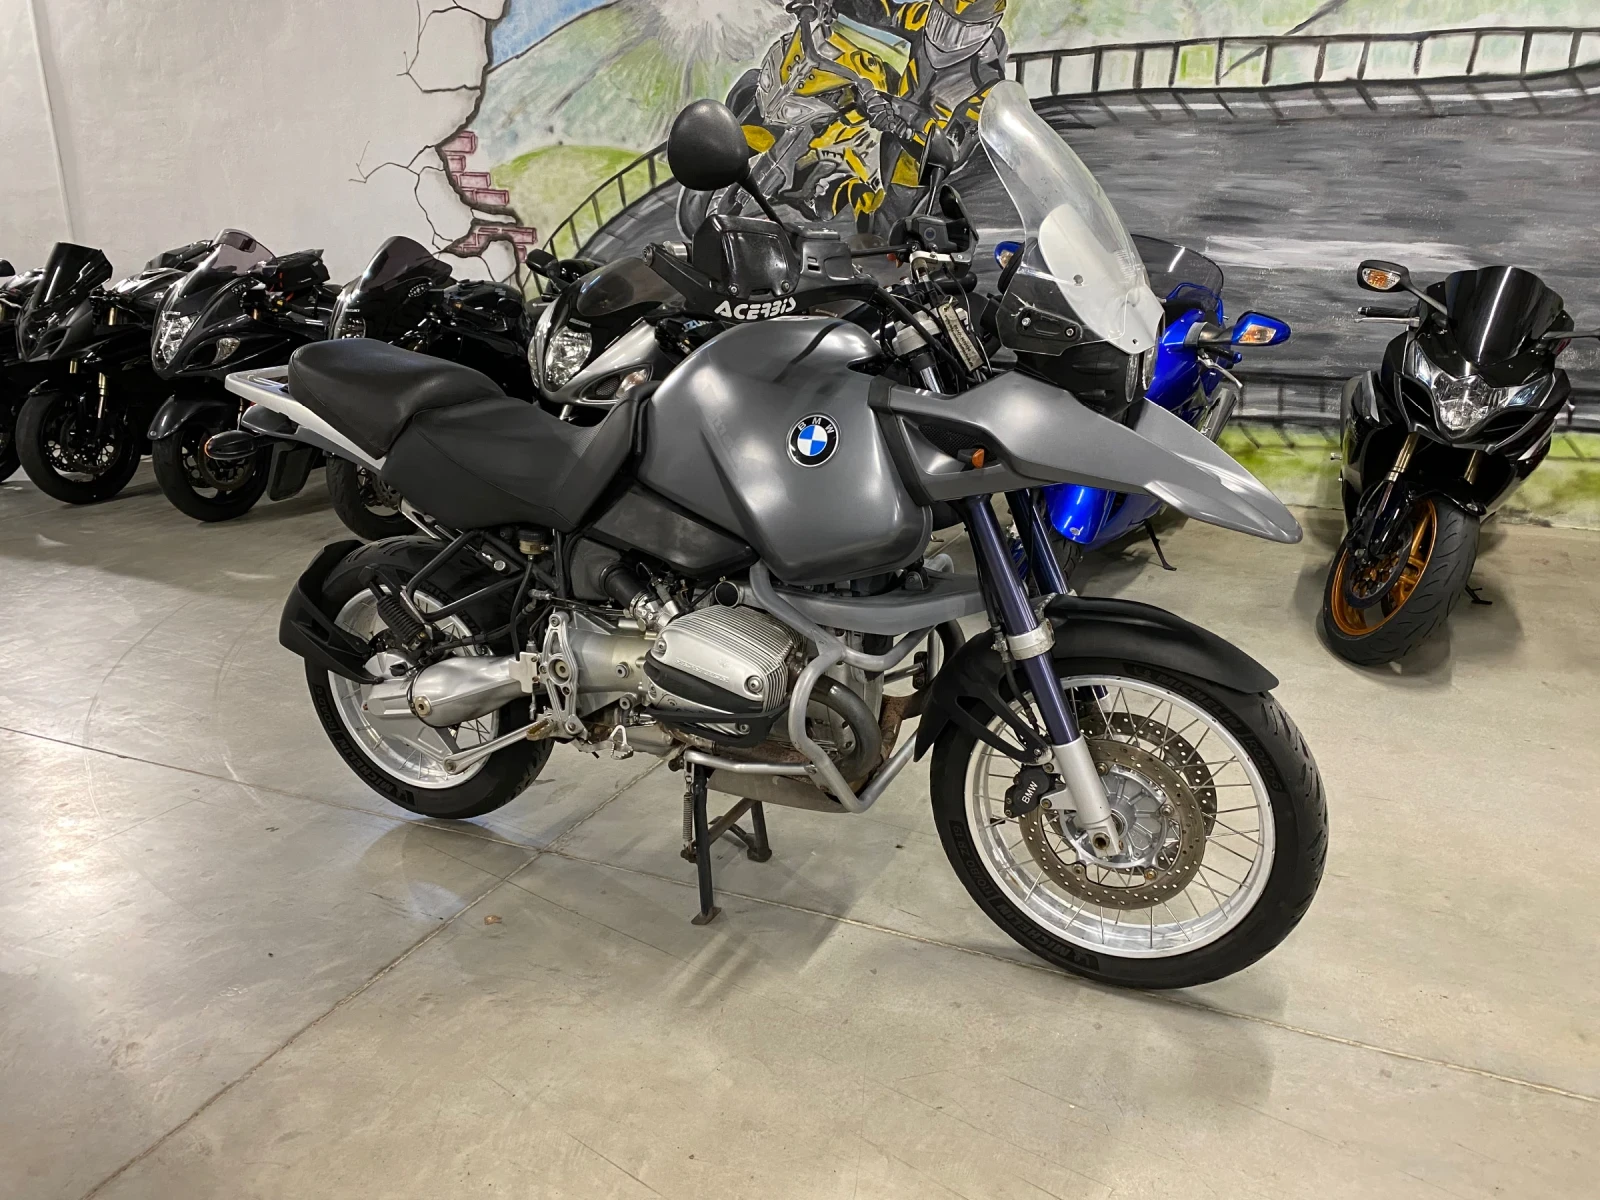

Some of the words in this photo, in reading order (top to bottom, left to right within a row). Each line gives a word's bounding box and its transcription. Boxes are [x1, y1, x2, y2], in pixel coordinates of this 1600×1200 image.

[714, 297, 796, 319] ACERBIS
[798, 417, 834, 434] BMW
[1158, 675, 1241, 733] MICHELIN
[1244, 739, 1275, 777] ROAD
[336, 738, 393, 793] MICHELIN
[1022, 781, 1038, 804] BMW
[966, 860, 994, 898] 110/80
[996, 903, 1070, 957] MICHELIN
